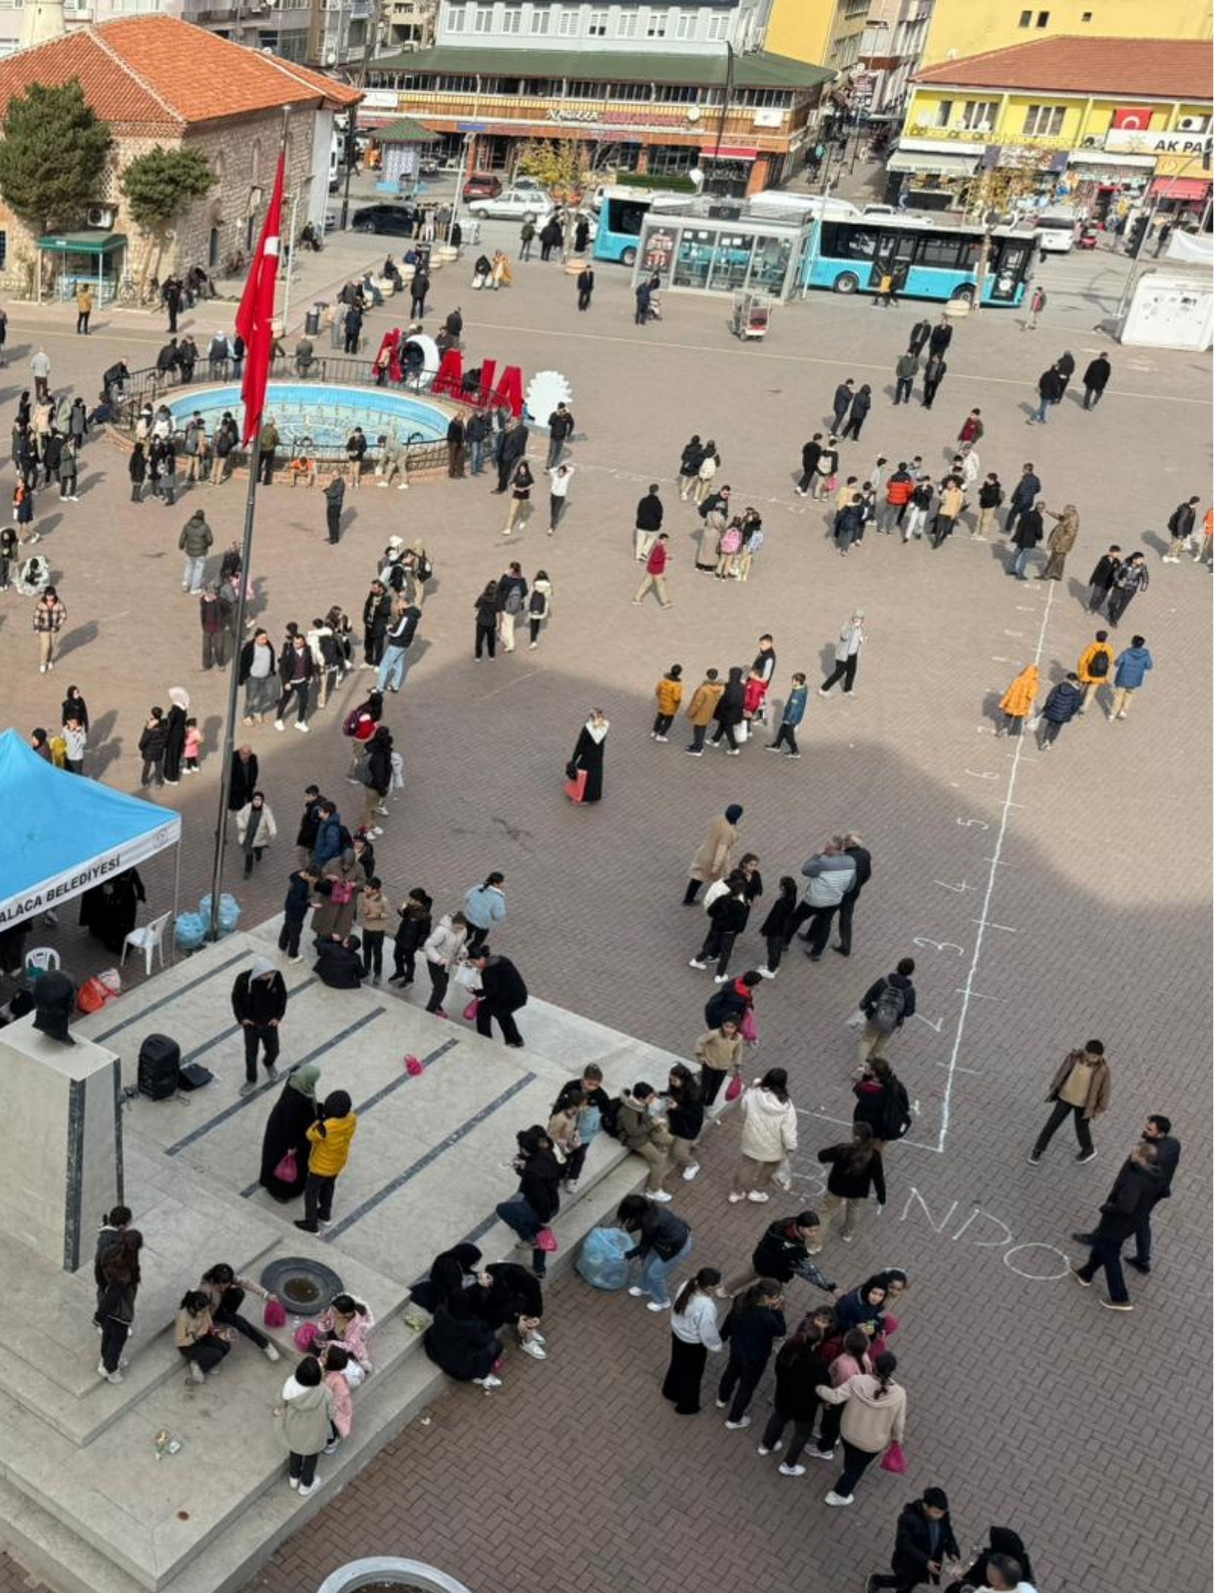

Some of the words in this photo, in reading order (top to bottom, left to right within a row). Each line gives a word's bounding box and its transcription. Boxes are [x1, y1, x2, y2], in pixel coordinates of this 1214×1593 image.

[1154, 139, 1179, 152] AK
[46, 854, 122, 902] BELEDİYESİ
[789, 1156, 1071, 1281] BNDO
